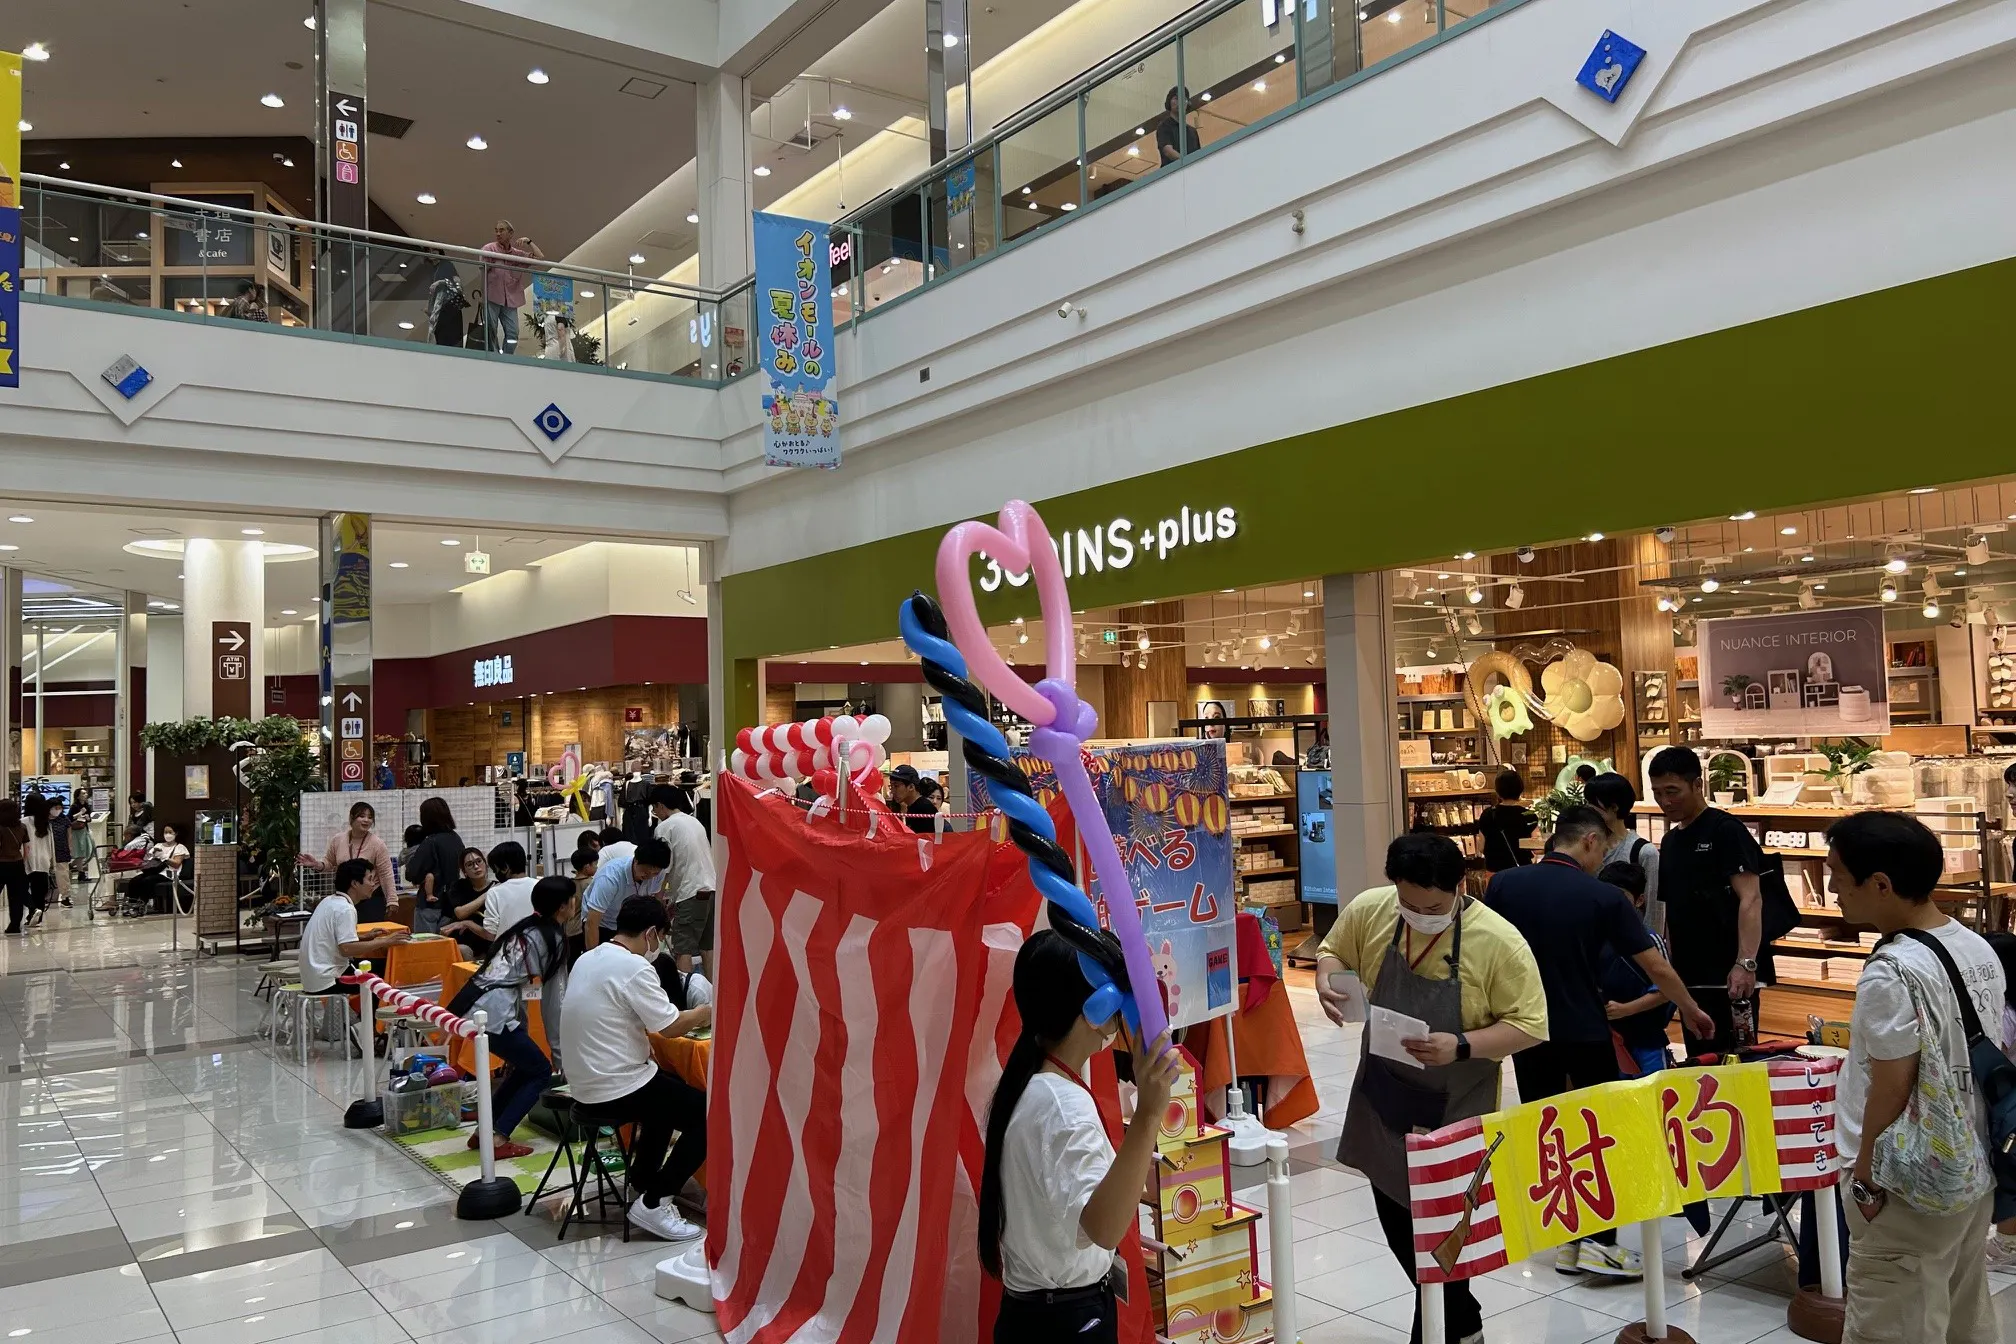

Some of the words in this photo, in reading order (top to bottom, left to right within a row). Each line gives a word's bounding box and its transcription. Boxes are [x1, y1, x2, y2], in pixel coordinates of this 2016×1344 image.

[193, 227, 233, 243] 書店
[768, 288, 801, 377] 夏休み
[794, 229, 825, 379] イオンモールの
[1720, 634, 1781, 651] NUANCE
[1785, 629, 1857, 646] INTERIOR
[473, 654, 514, 688] 無印良品
[1208, 953, 1228, 968] GAME
[1803, 1067, 1828, 1173] しゃてき
[1528, 1072, 1744, 1235] 射的
